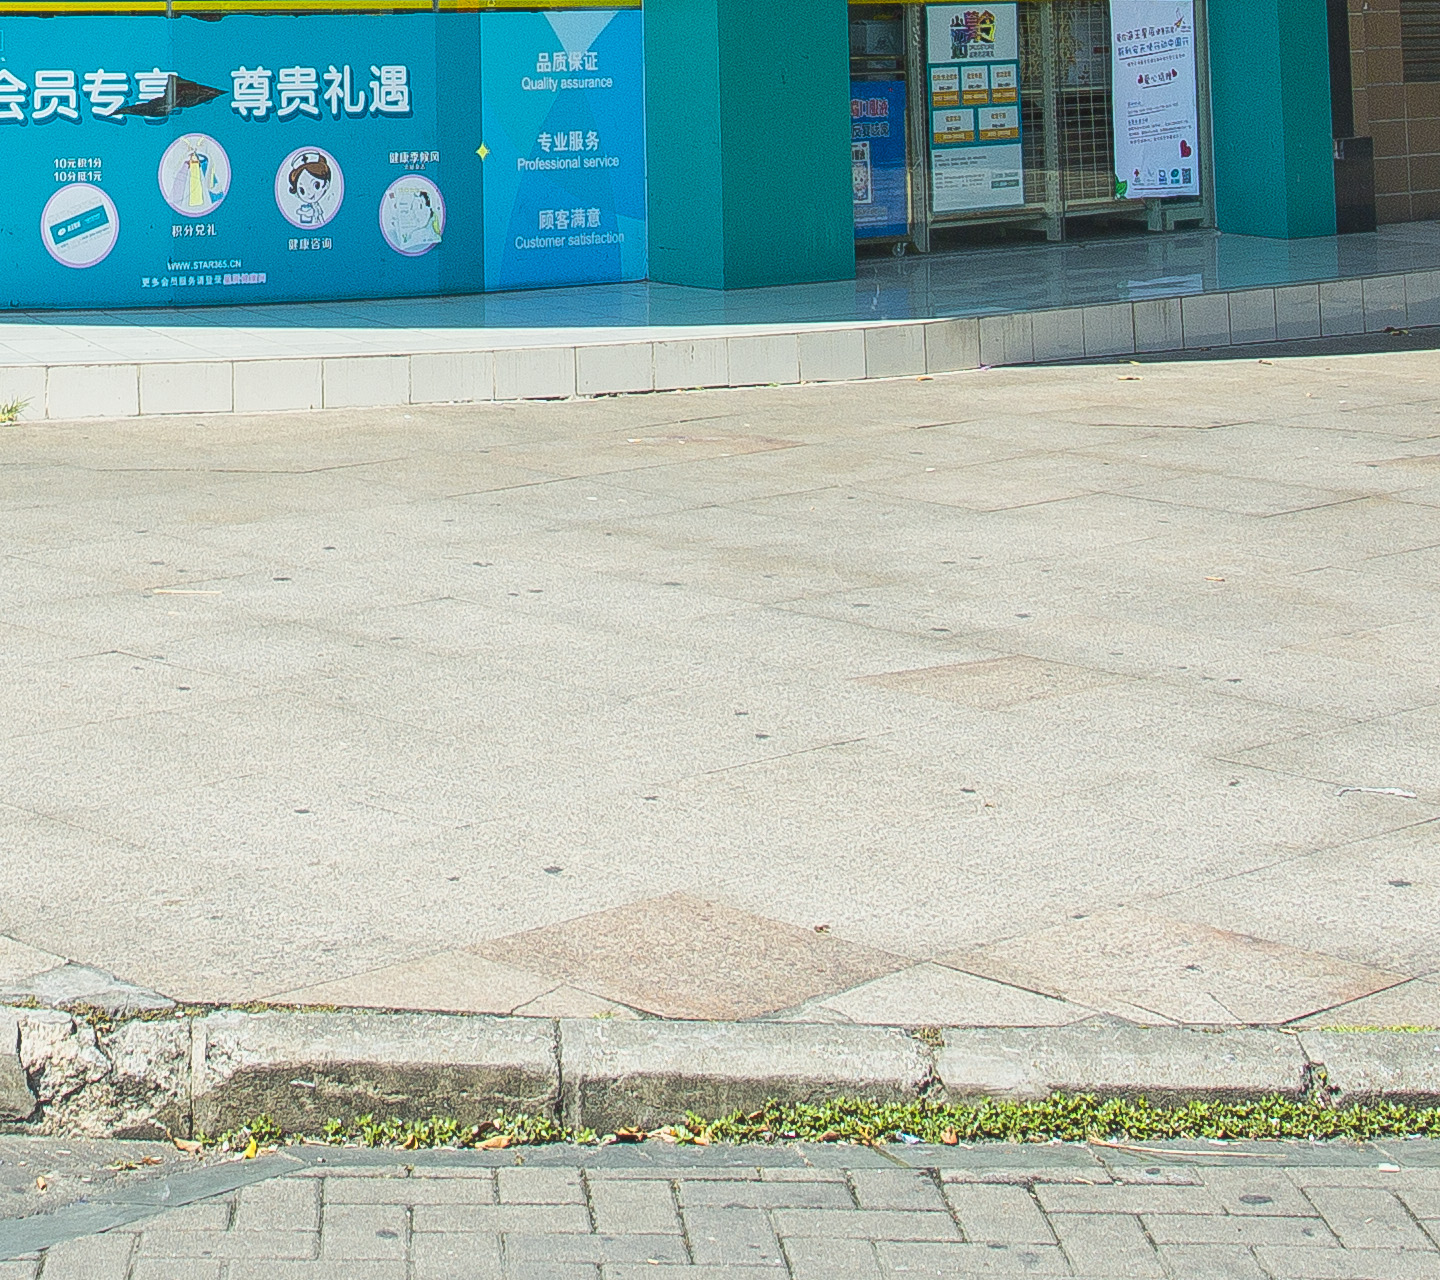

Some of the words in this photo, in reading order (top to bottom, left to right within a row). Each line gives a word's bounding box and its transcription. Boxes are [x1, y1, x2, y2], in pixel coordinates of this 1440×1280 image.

[536, 51, 599, 73] 品质保证
[230, 64, 411, 118] 尊贵礼遇
[521, 77, 558, 92] Quality
[561, 76, 613, 90] assurance
[537, 130, 600, 153] 专业服务
[53, 157, 102, 169] 10元积1分
[517, 156, 580, 171] Professional
[583, 156, 619, 169] service
[53, 171, 103, 182] 10分抵1元
[538, 207, 602, 231] 顾客满意
[288, 237, 333, 251] 健康咨询
[515, 236, 565, 250] Customer
[568, 231, 625, 247] satisfaction
[167, 259, 242, 271] WWW.STAR365.CN
